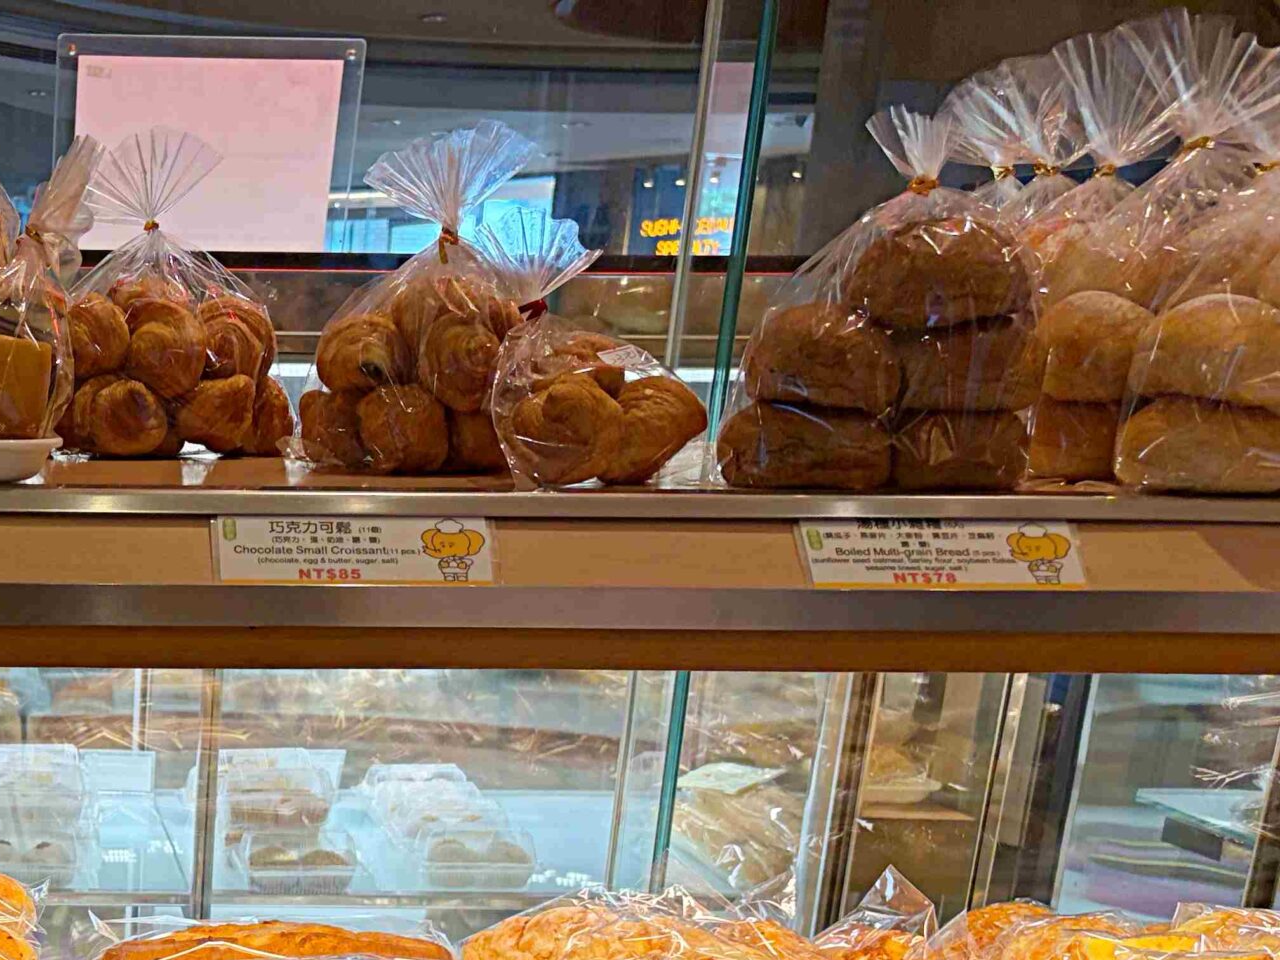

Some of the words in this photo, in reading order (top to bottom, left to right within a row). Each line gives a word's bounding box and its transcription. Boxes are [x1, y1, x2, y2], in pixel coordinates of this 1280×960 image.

[233, 544, 293, 554] Chocolate
[296, 545, 328, 554] Small
[835, 547, 870, 556] Boiled
[936, 548, 970, 556] Bread
[298, 568, 361, 579] NT$85
[893, 572, 957, 584] NT$78
